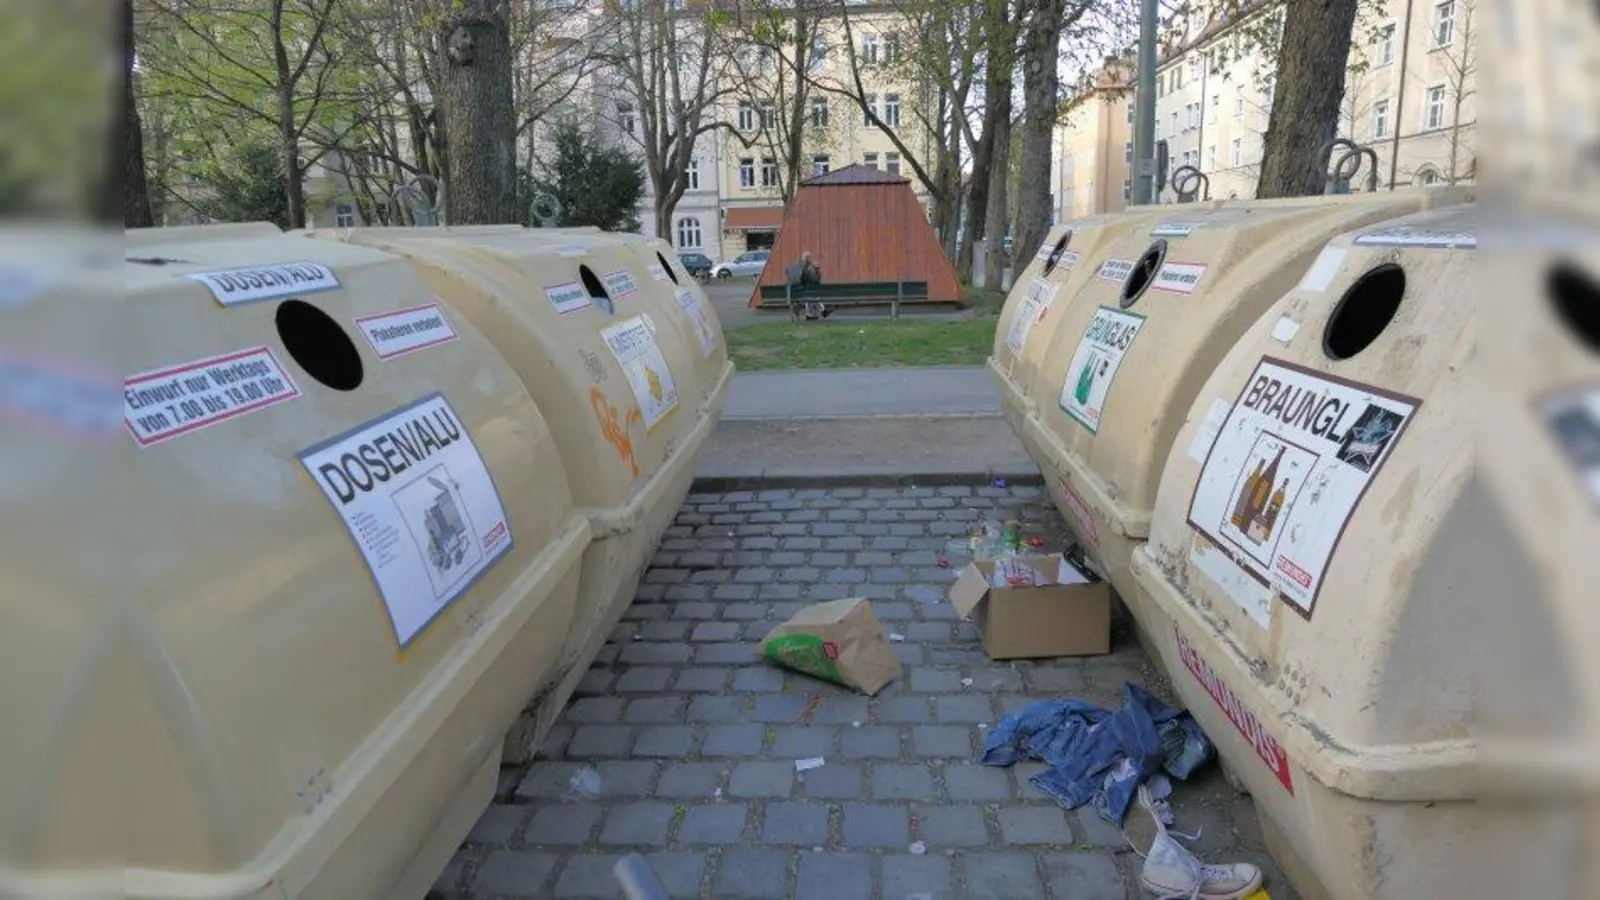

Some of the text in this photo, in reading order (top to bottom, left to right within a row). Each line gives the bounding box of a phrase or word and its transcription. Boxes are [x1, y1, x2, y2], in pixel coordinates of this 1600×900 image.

[125, 359, 271, 409] Einwurf nur Werktags
[137, 377, 288, 433] von 7.00 bis 19.00 Uhr
[1243, 376, 1350, 445] BRAUNGL
[318, 408, 461, 505] DOSEN/ALU
